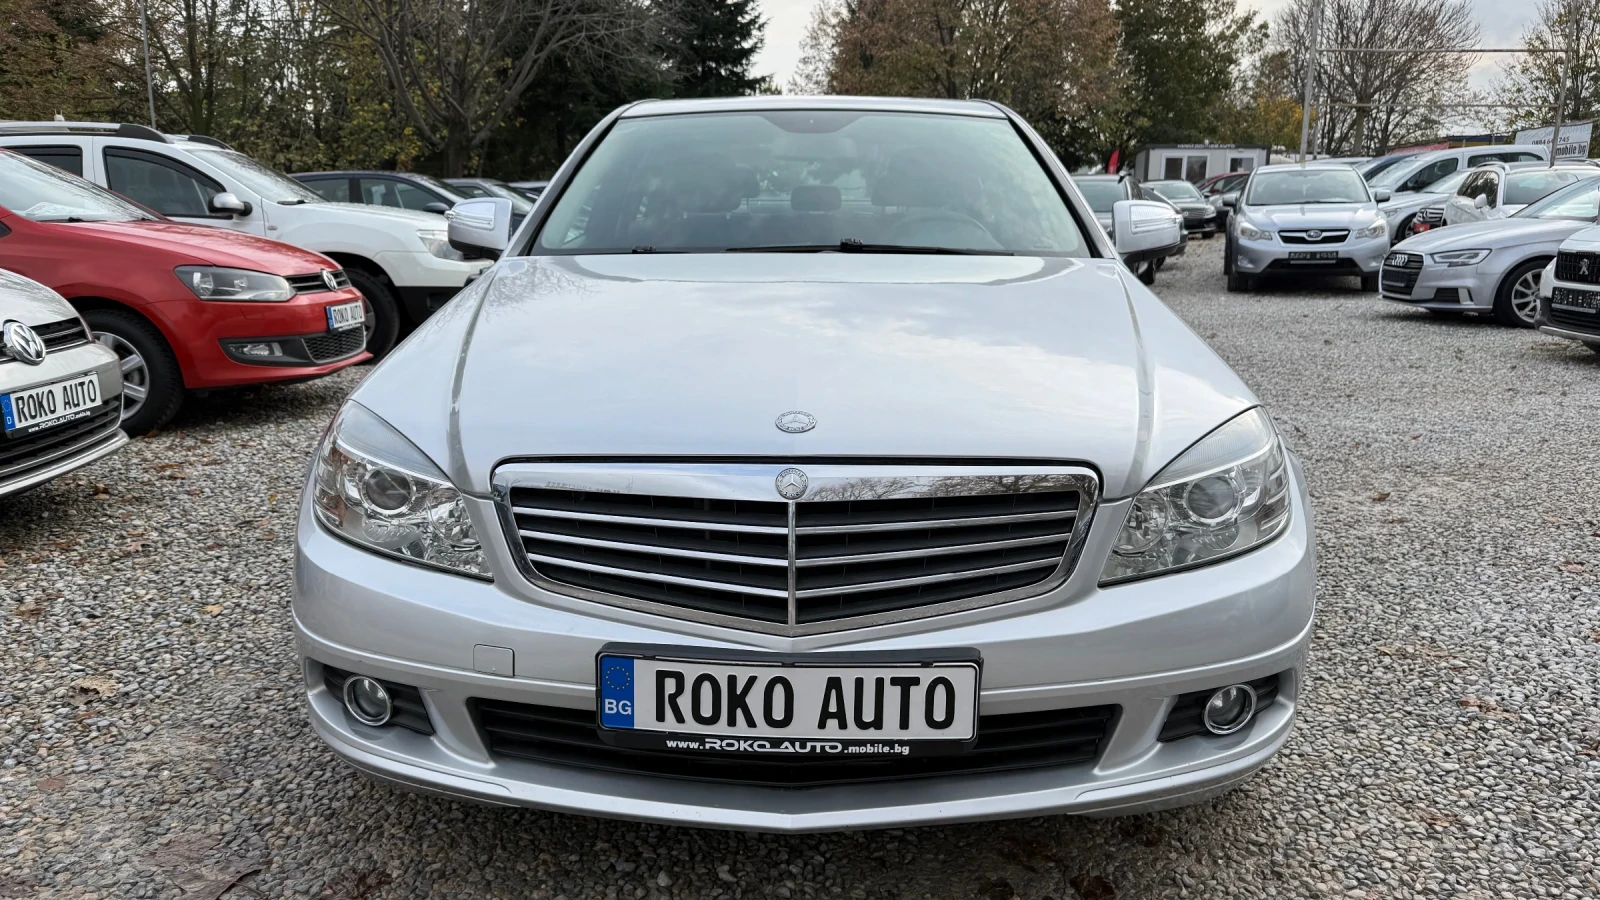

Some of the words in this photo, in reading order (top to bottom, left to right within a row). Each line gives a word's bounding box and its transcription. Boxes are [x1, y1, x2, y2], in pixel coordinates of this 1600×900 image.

[333, 307, 349, 325] ROKO
[350, 304, 363, 321] AUTO
[15, 389, 56, 423] ROKO
[62, 379, 96, 411] AUTO
[6, 416, 12, 425] D
[604, 698, 632, 716] BG
[655, 669, 794, 729] ROKO
[817, 676, 956, 731] AUTO
